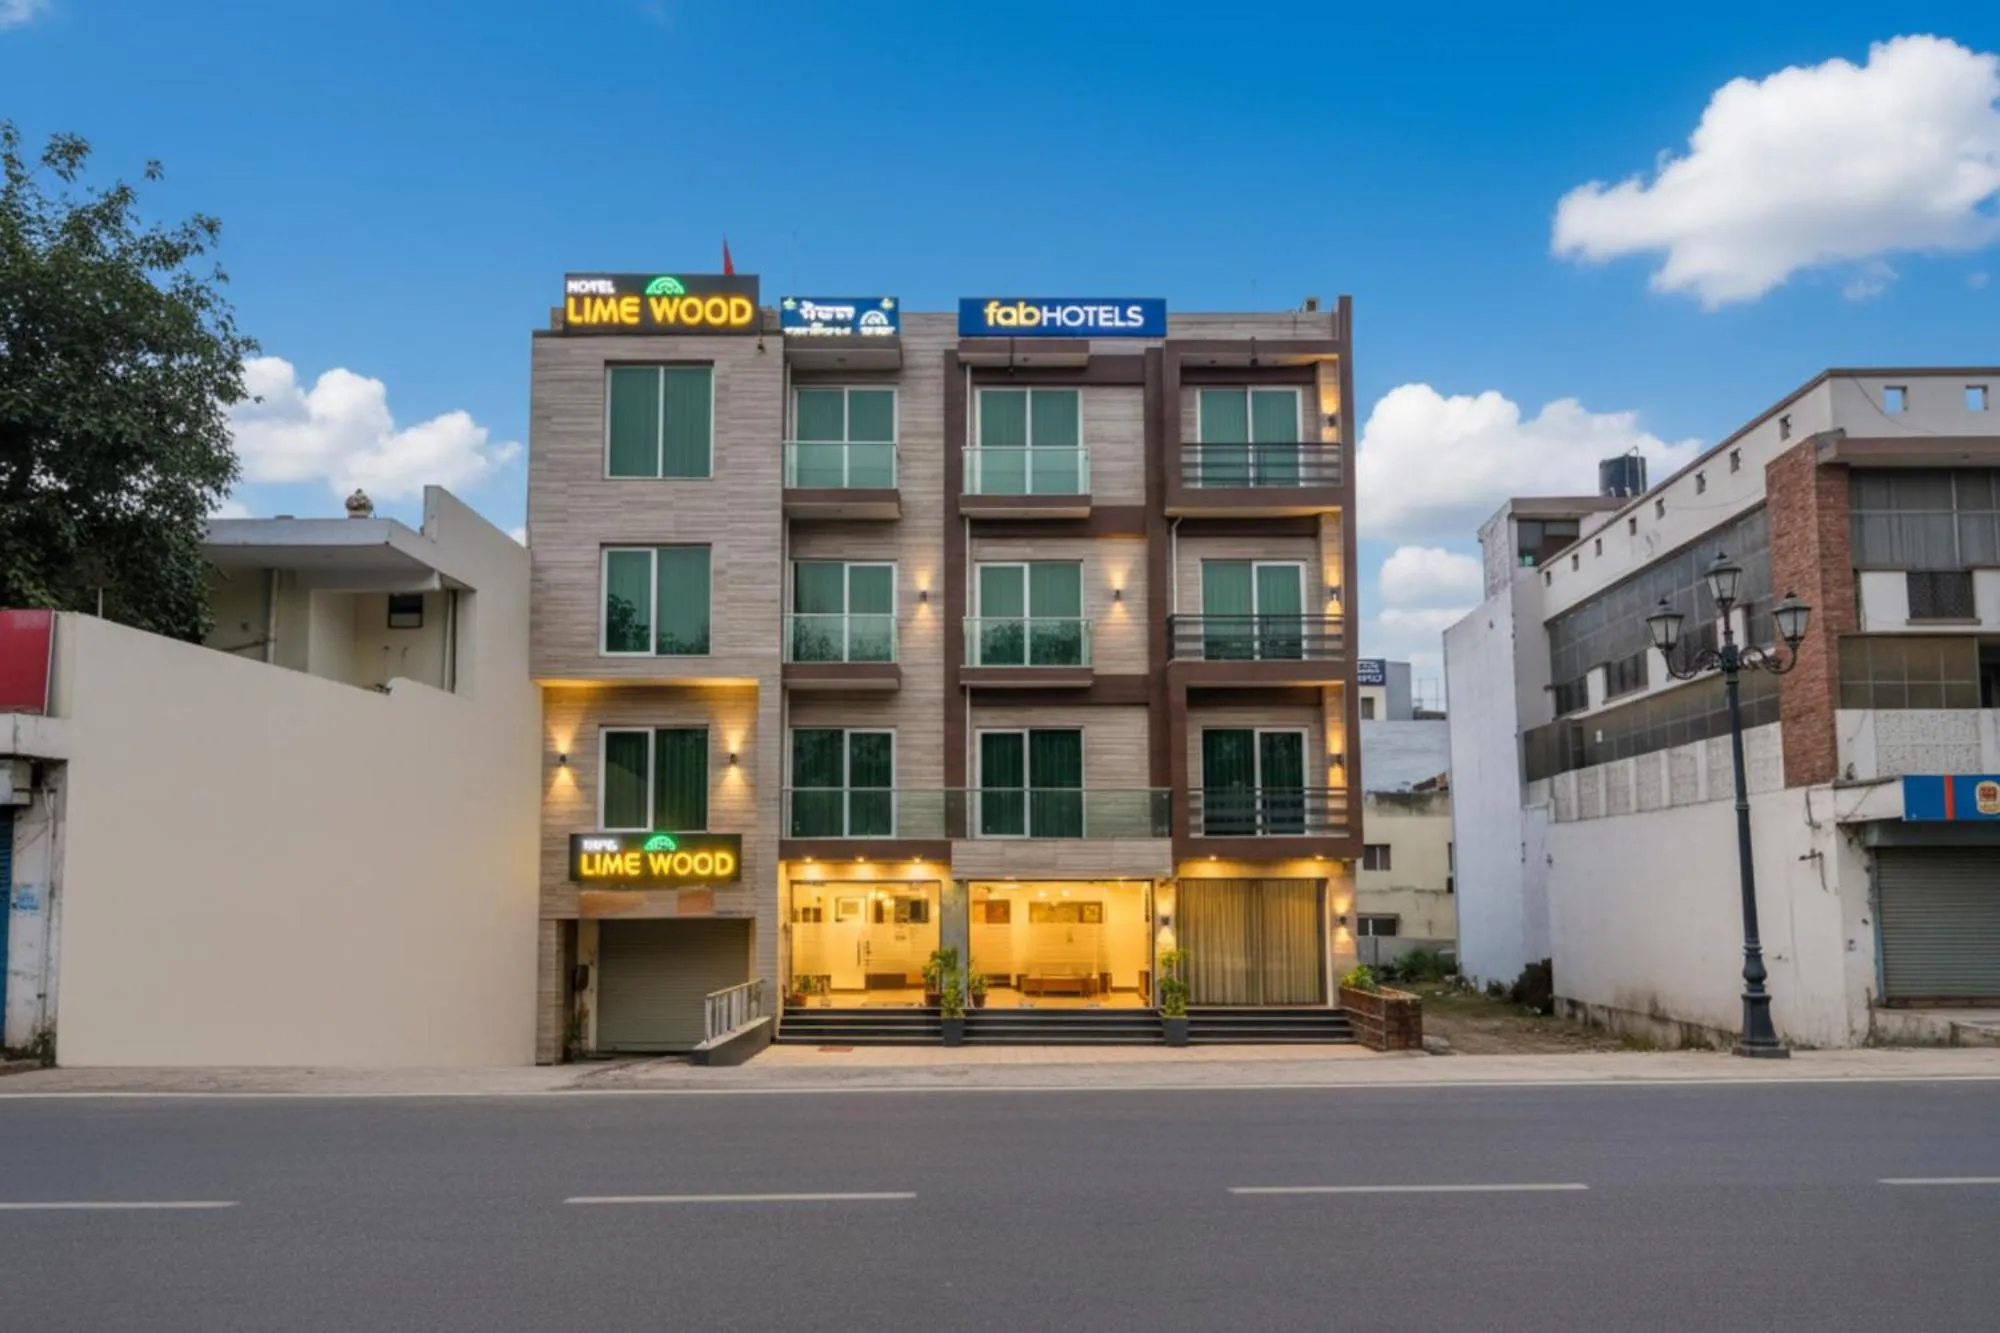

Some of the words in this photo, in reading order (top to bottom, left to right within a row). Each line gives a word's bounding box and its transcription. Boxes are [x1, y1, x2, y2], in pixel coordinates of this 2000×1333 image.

[567, 280, 616, 294] HOTEL
[567, 297, 641, 325] LIME
[649, 297, 753, 325] WOOD
[984, 301, 1144, 327] fabHOTELS
[581, 853, 641, 876] LIME
[648, 853, 735, 876] WOOD
